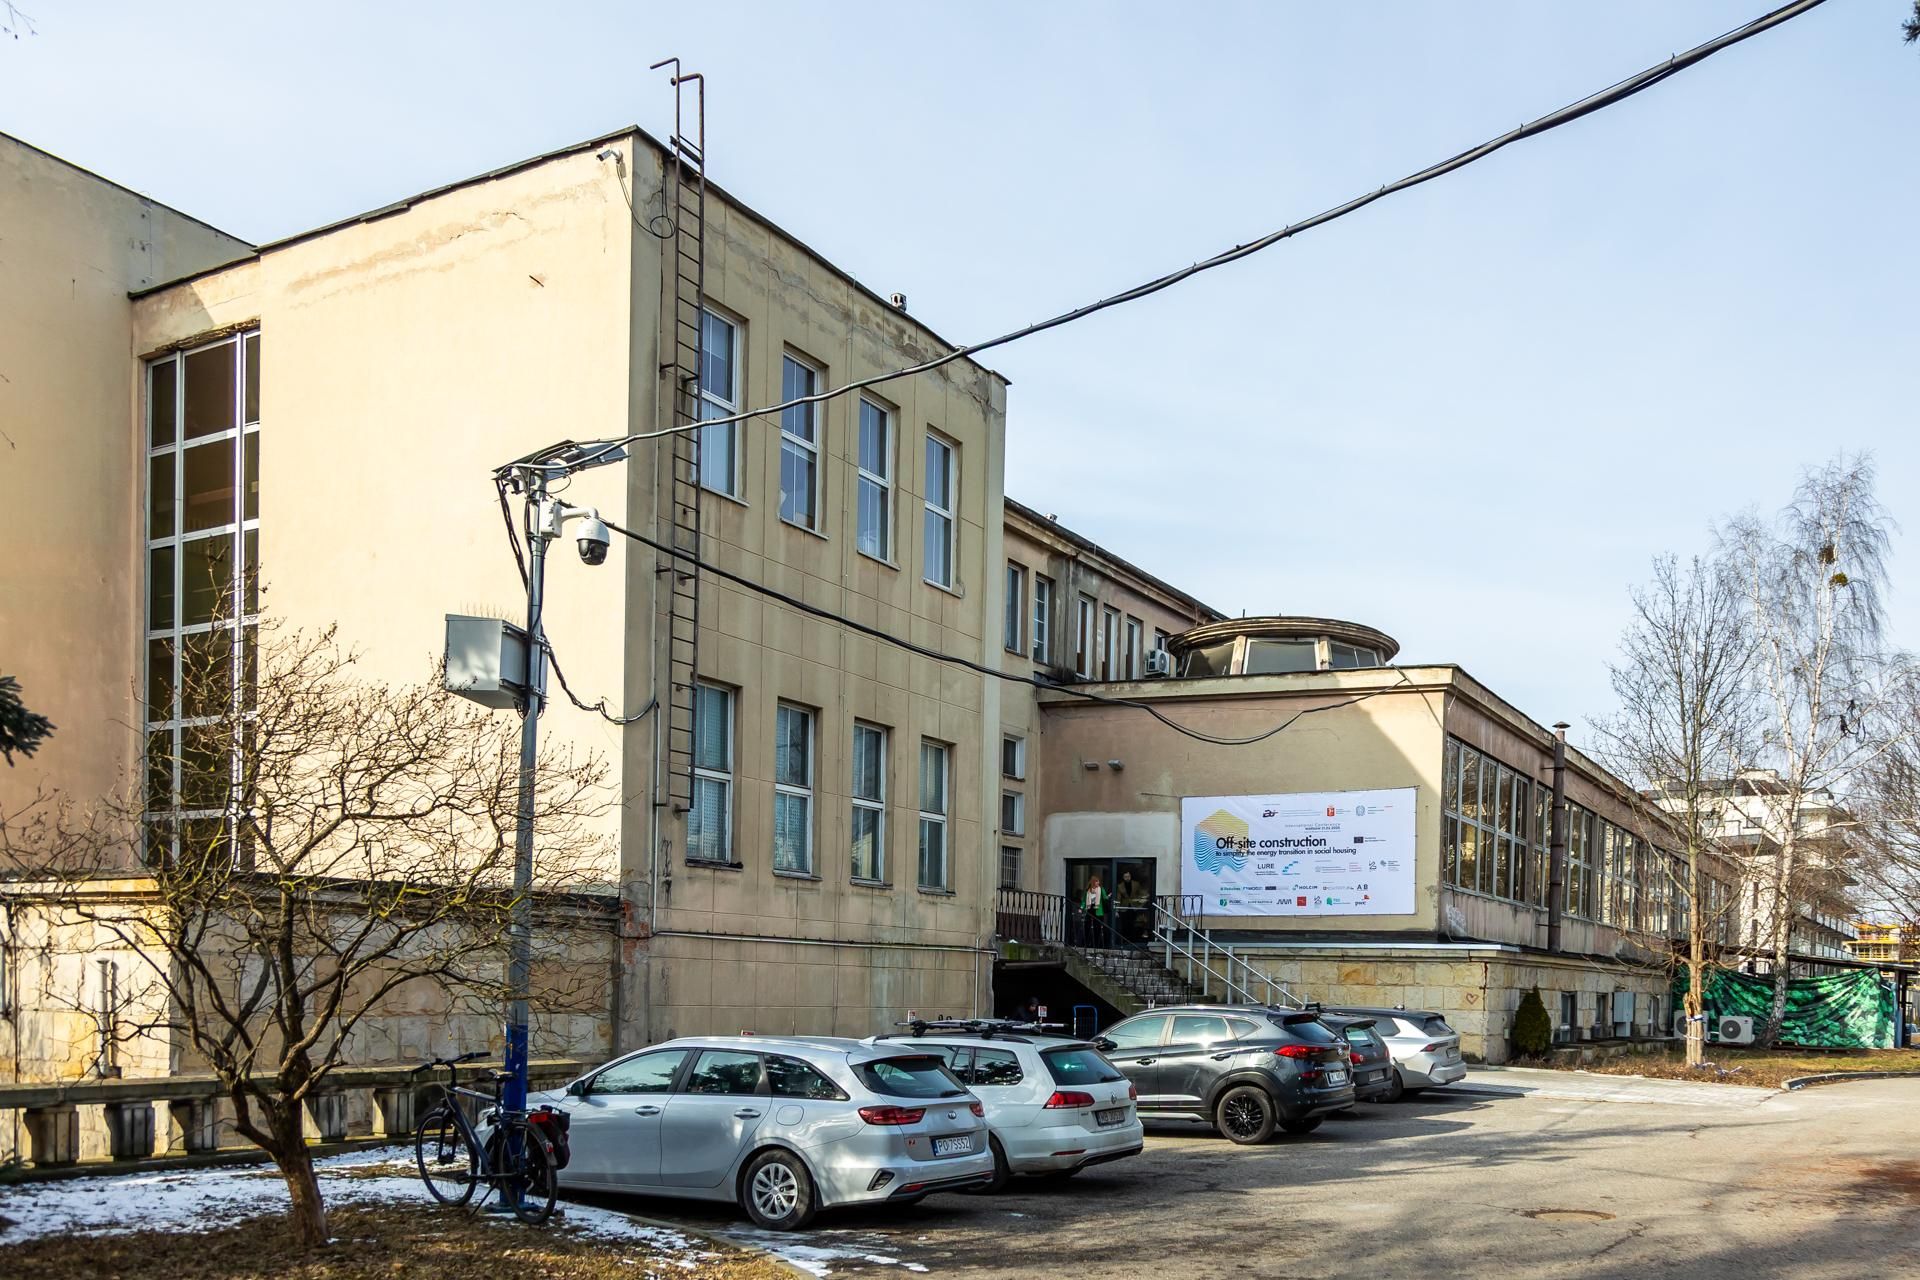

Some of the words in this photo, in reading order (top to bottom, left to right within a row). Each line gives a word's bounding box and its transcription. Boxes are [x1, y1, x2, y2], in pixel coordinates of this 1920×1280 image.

[1216, 836, 1256, 849] Off-site
[1259, 835, 1327, 848] construction
[1222, 848, 1244, 858] simplify
[1256, 850, 1277, 858] energy
[1278, 847, 1306, 855] transition
[1314, 846, 1331, 854] social
[1332, 846, 1357, 856] housing
